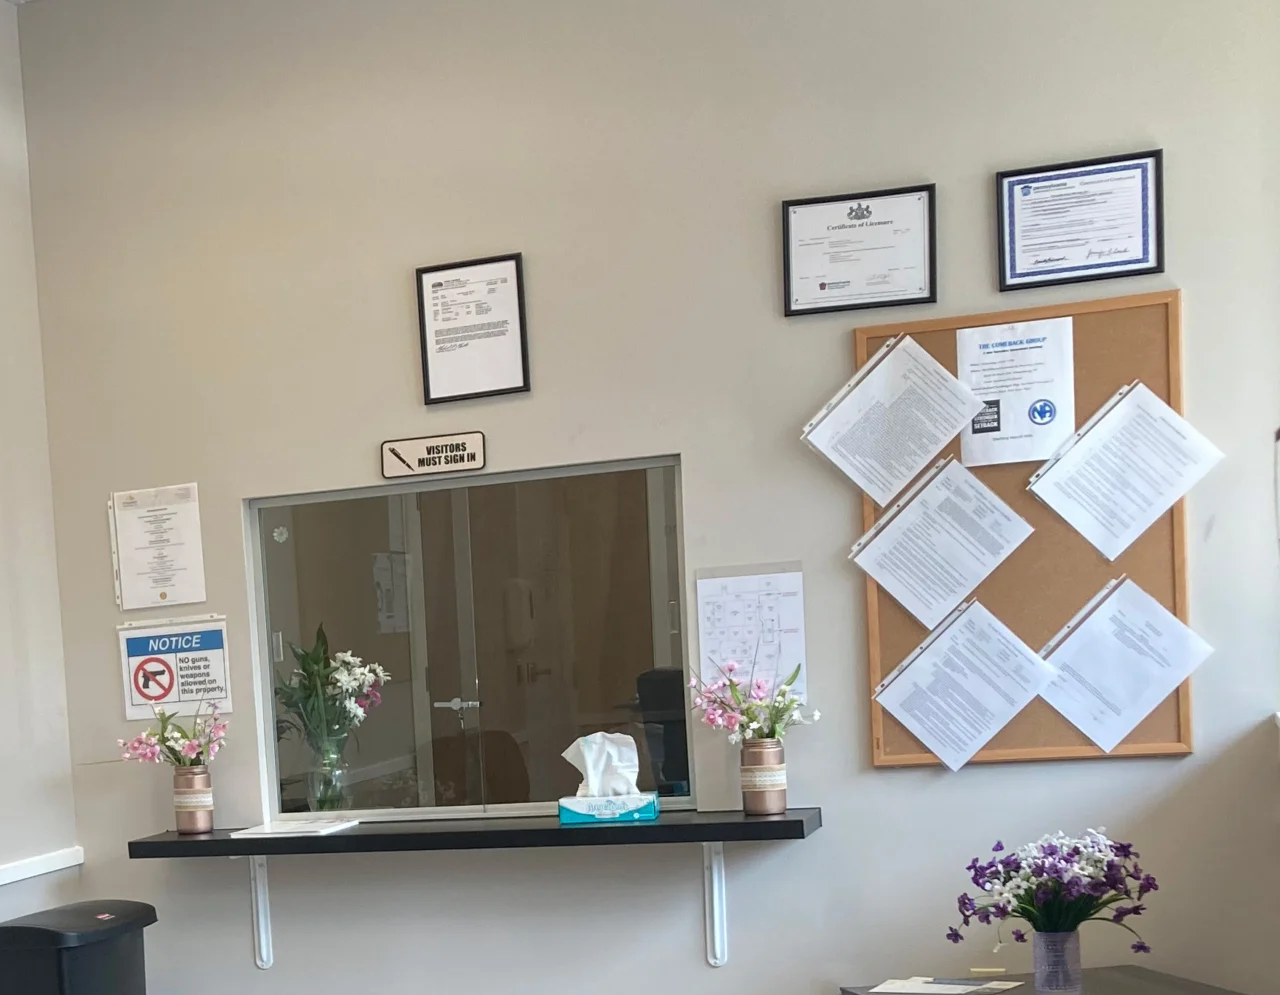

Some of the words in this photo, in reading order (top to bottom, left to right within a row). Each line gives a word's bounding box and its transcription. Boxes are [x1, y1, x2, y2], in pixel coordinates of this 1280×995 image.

[991, 340, 1024, 348] COMEBACK
[426, 442, 467, 455] VISITORS
[418, 456, 442, 467] MUST
[444, 453, 465, 465] SIGN
[467, 452, 476, 462] IN
[148, 635, 201, 651] NOTICE
[191, 656, 210, 664] guns,
[180, 671, 210, 679] weapons
[181, 679, 206, 687] allowed
[195, 685, 225, 695] property.
